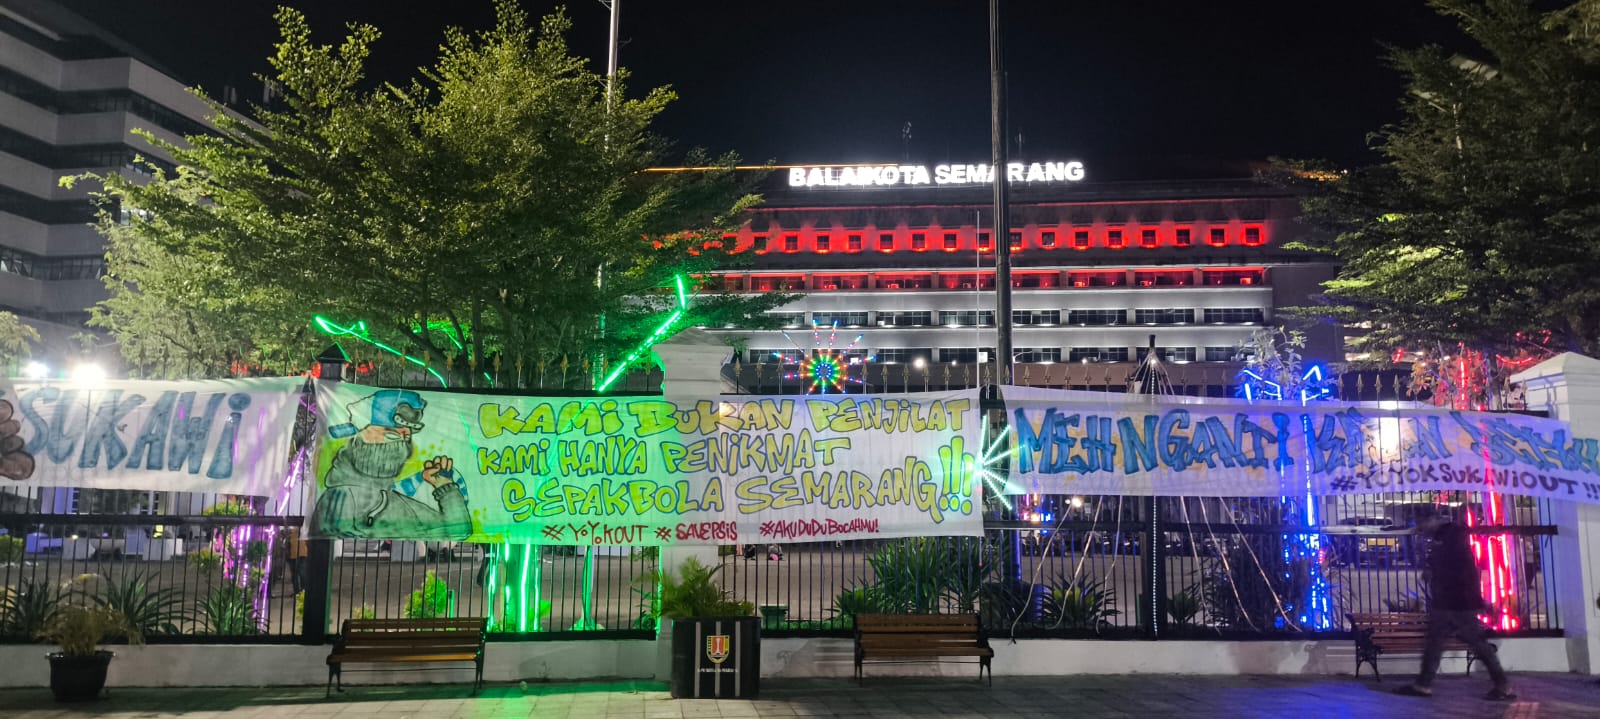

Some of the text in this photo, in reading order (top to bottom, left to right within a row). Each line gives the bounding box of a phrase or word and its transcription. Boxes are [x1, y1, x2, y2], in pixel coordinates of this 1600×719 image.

[788, 165, 930, 187] BALAIKOTA
[557, 435, 648, 477] HANYA
[502, 477, 724, 522] SEPAKBOLA
